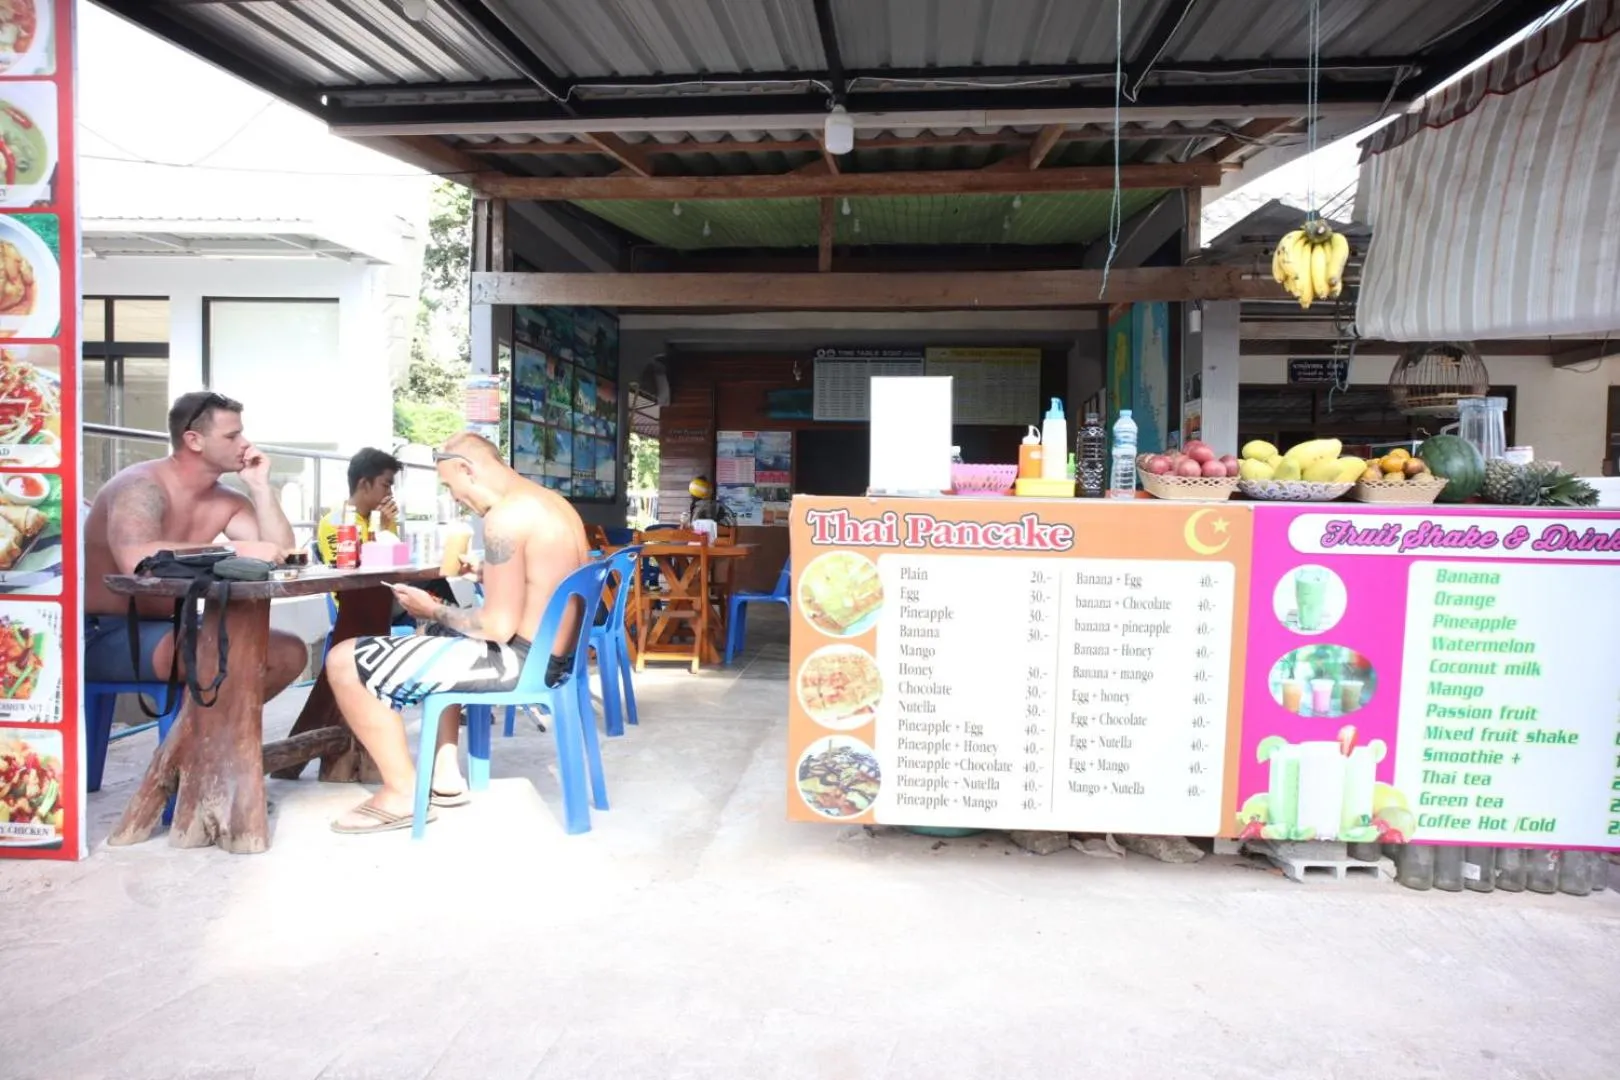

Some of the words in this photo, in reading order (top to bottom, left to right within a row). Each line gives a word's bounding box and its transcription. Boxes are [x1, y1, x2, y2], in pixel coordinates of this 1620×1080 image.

[806, 509, 900, 548] Thai
[903, 512, 1075, 551] Pancake
[1320, 520, 1401, 548] Fruit
[1399, 520, 1499, 552] Shake
[1503, 525, 1530, 549] &
[900, 567, 928, 580] Plain
[1031, 571, 1052, 583] 20.-
[1076, 572, 1113, 585] Banana
[1124, 573, 1142, 589] Egg
[1436, 568, 1501, 585] Banana
[900, 587, 919, 602] Egg
[1075, 595, 1111, 609] banana
[1123, 596, 1172, 610] Chocolate
[1434, 590, 1495, 610] Orange
[900, 606, 954, 622] Pineapple
[1074, 618, 1110, 632] banana
[1122, 620, 1171, 637] pineapple
[1432, 613, 1517, 633] Pineapple
[900, 625, 940, 638] Banana
[900, 644, 935, 659] Mango
[1074, 642, 1110, 656] Banana
[1121, 644, 1154, 660] Honey
[1432, 636, 1535, 653] Watermelon
[899, 663, 933, 679] Honey
[1073, 666, 1108, 679] Banana
[1120, 669, 1154, 684] mango
[1429, 658, 1497, 674] Coconut
[1504, 661, 1541, 676] milk
[898, 682, 952, 695] Chocolate
[1428, 682, 1484, 699] Mango
[1072, 689, 1089, 705] Egg
[1101, 689, 1130, 705] honey
[899, 700, 936, 713] Nutella
[1426, 704, 1492, 719] Passion
[1500, 705, 1538, 720] fruit
[898, 719, 951, 735] Pineapple
[964, 722, 983, 736] Egg
[1071, 712, 1088, 727] Egg
[1099, 713, 1147, 726] Chocolate
[1070, 735, 1087, 750] Egg
[1099, 736, 1132, 749] Nutella
[1424, 726, 1474, 741] Mixed
[1480, 728, 1519, 742] fruit
[1525, 729, 1579, 744] shake
[898, 738, 951, 754] Pineapple
[964, 740, 998, 756] Honey
[1423, 748, 1503, 764] Smoothie
[897, 756, 950, 773] Pineapple
[954, 758, 1013, 772] +Chocolate
[1069, 757, 1086, 773] Egg
[1097, 759, 1130, 773] Mango
[897, 775, 949, 791] Pineapple
[963, 777, 1000, 790] Nutella
[1422, 770, 1457, 785] Thai
[1463, 773, 1492, 786] tea
[1068, 780, 1100, 796] Mango
[1111, 782, 1145, 795] Nutella
[897, 794, 949, 809] Pineapple
[962, 796, 997, 812] Mango
[1420, 791, 1468, 807] Green
[1476, 795, 1504, 808] tea
[1418, 813, 1471, 829] Coffee
[1478, 816, 1508, 830] Hot
[1514, 816, 1556, 832] /Cold
[8, 826, 49, 836] CHICKEN
